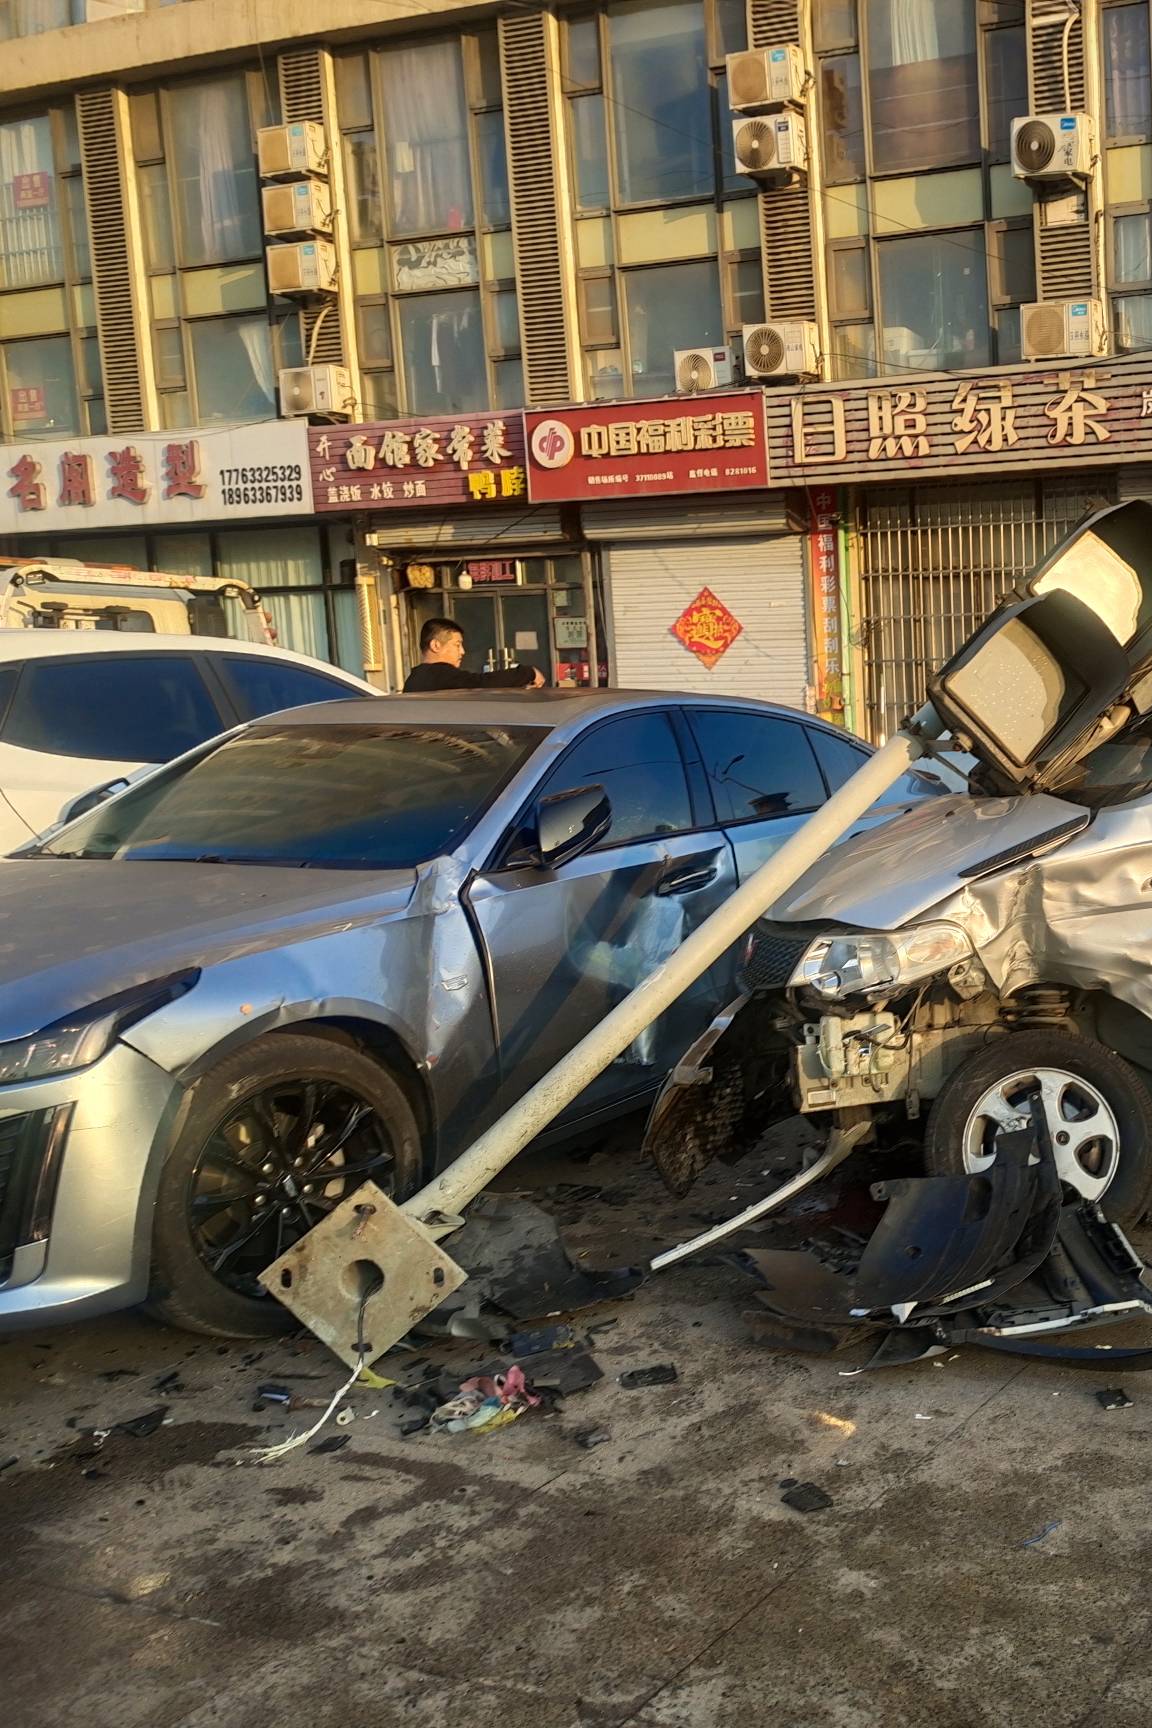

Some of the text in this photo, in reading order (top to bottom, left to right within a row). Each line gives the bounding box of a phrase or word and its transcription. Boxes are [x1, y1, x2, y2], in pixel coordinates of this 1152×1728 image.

[580, 411, 755, 458] 中国福利彩票
[790, 371, 1113, 464] 日照绿茶
[346, 420, 513, 470] 面馆家常菜
[219, 465, 302, 486] 17763325329
[221, 484, 304, 506] 18963367939
